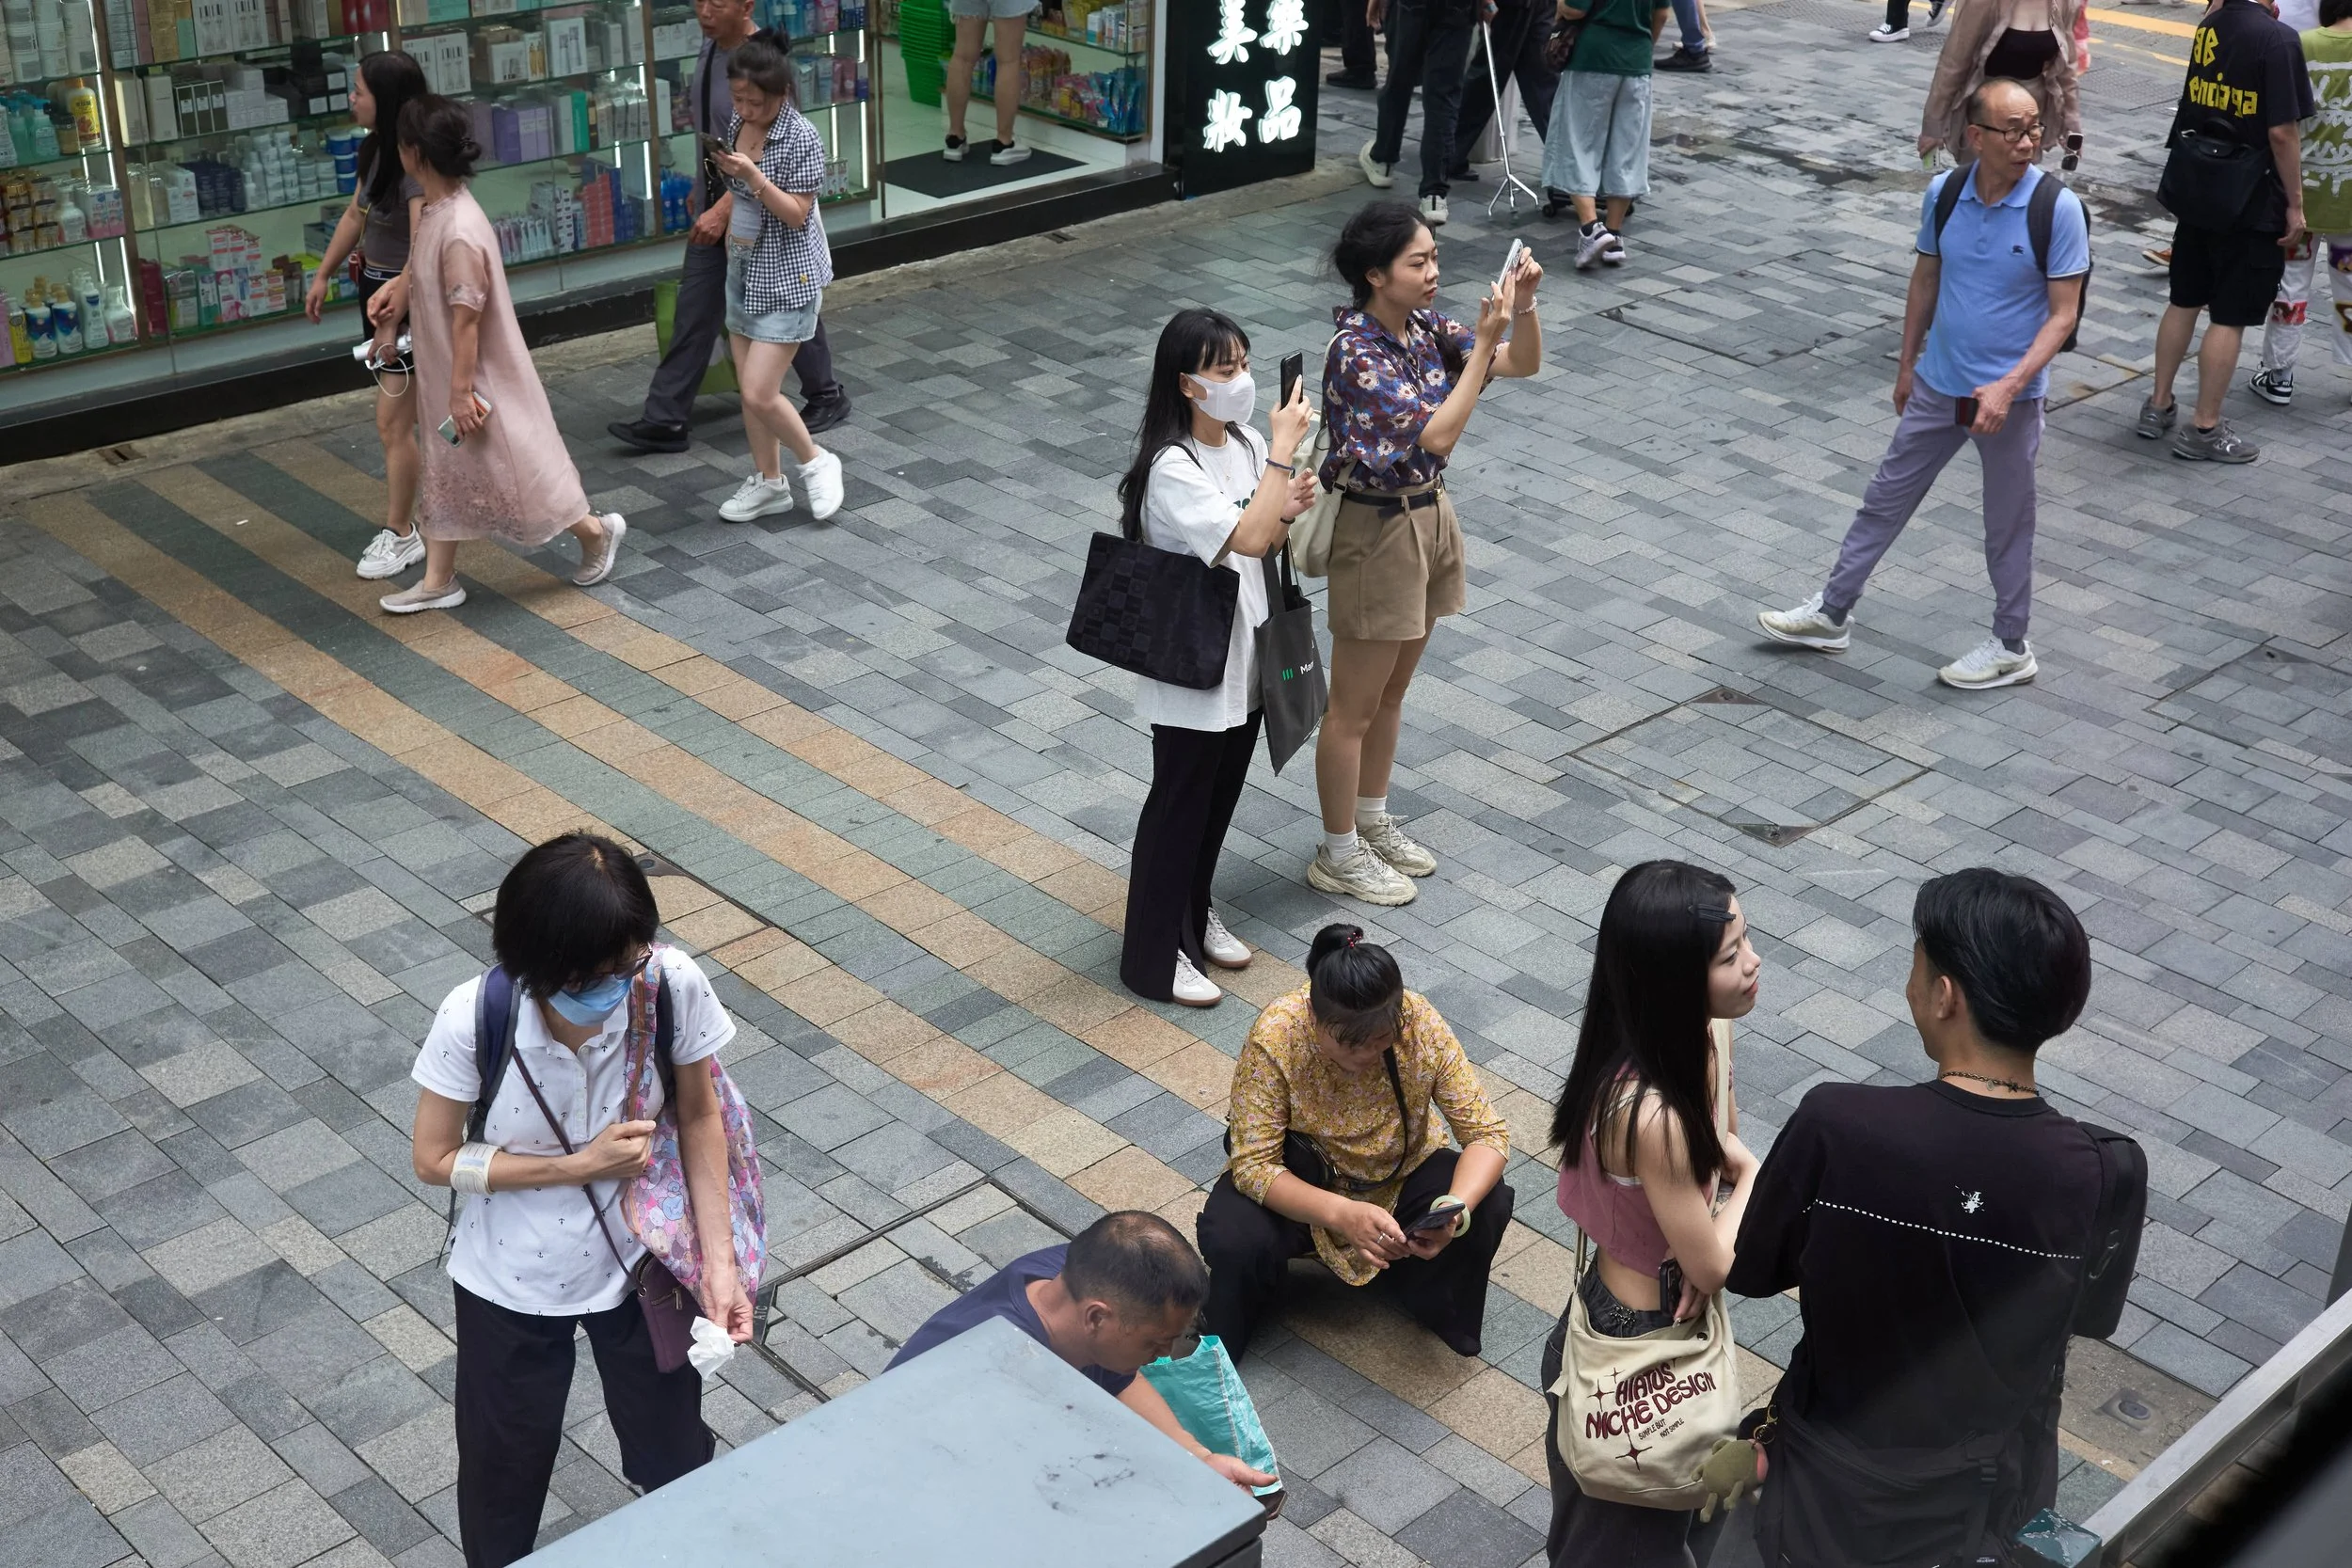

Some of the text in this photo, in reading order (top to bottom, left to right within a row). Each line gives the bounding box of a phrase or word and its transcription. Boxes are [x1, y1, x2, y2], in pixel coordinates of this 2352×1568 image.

[1586, 1371, 1717, 1439] NICHE DESIGN
[1615, 1362, 1676, 1406] HIATUS
[1654, 1418, 1667, 1432] BUT
